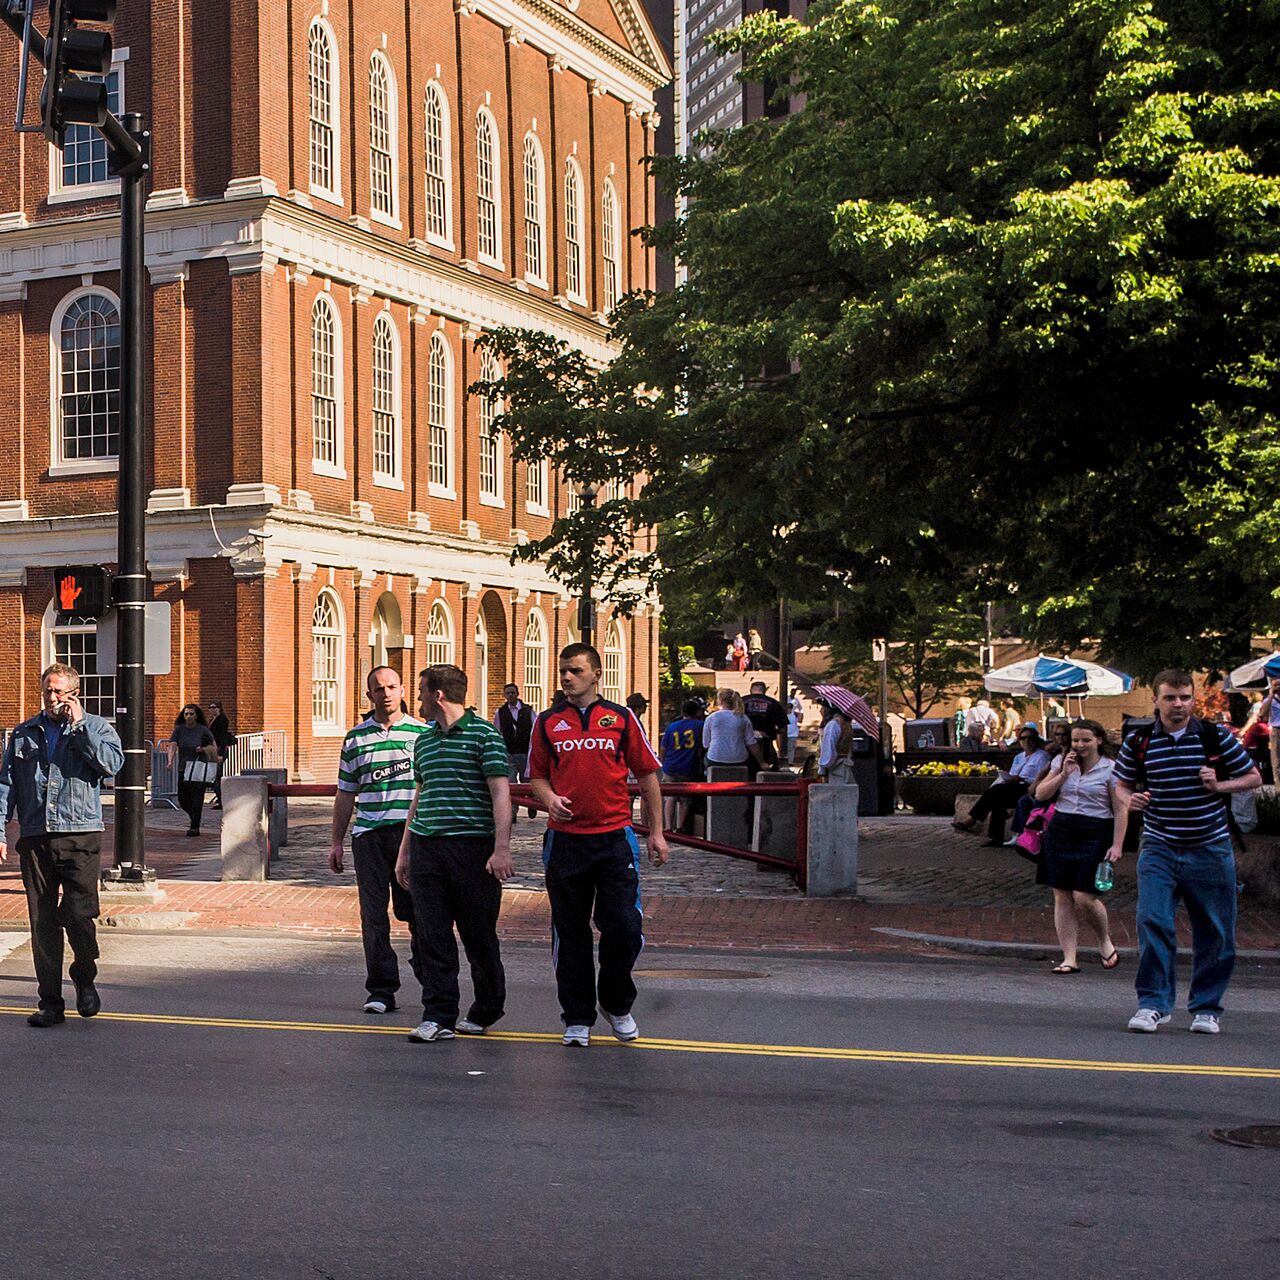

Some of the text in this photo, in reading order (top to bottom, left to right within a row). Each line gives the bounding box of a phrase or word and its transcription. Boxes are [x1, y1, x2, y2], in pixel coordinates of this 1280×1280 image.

[553, 738, 615, 753] TOYOTA
[673, 729, 695, 750] 13
[372, 761, 410, 781] CARLING
